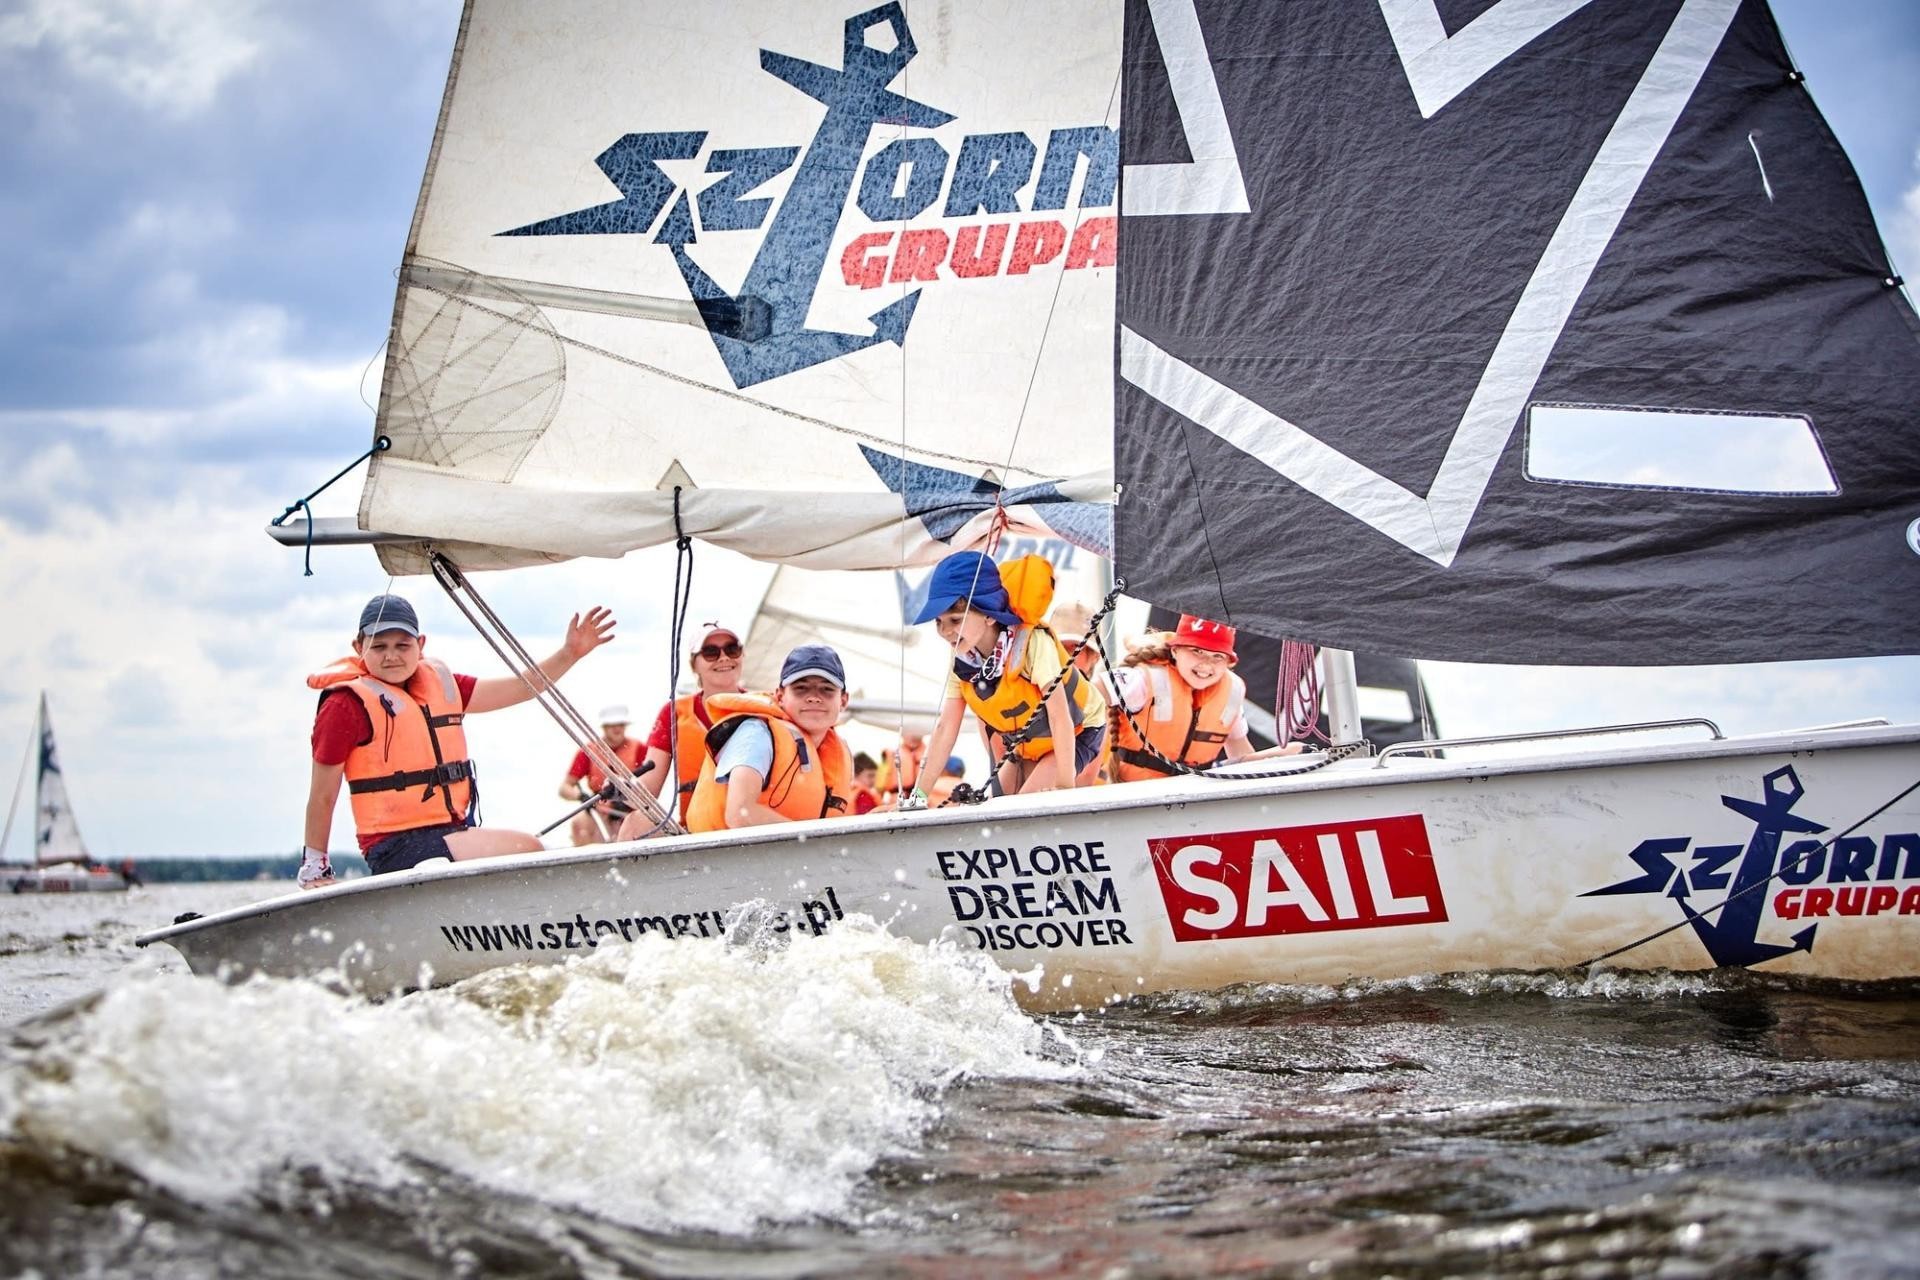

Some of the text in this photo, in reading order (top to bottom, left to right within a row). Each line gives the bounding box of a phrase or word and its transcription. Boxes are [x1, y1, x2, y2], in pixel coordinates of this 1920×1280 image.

[841, 216, 1118, 290] GRUPA
[936, 841, 1111, 880] EXPLORE
[1170, 829, 1430, 930] SAIL
[947, 878, 1121, 921] DREAM
[1774, 886, 1920, 921] GRUPA
